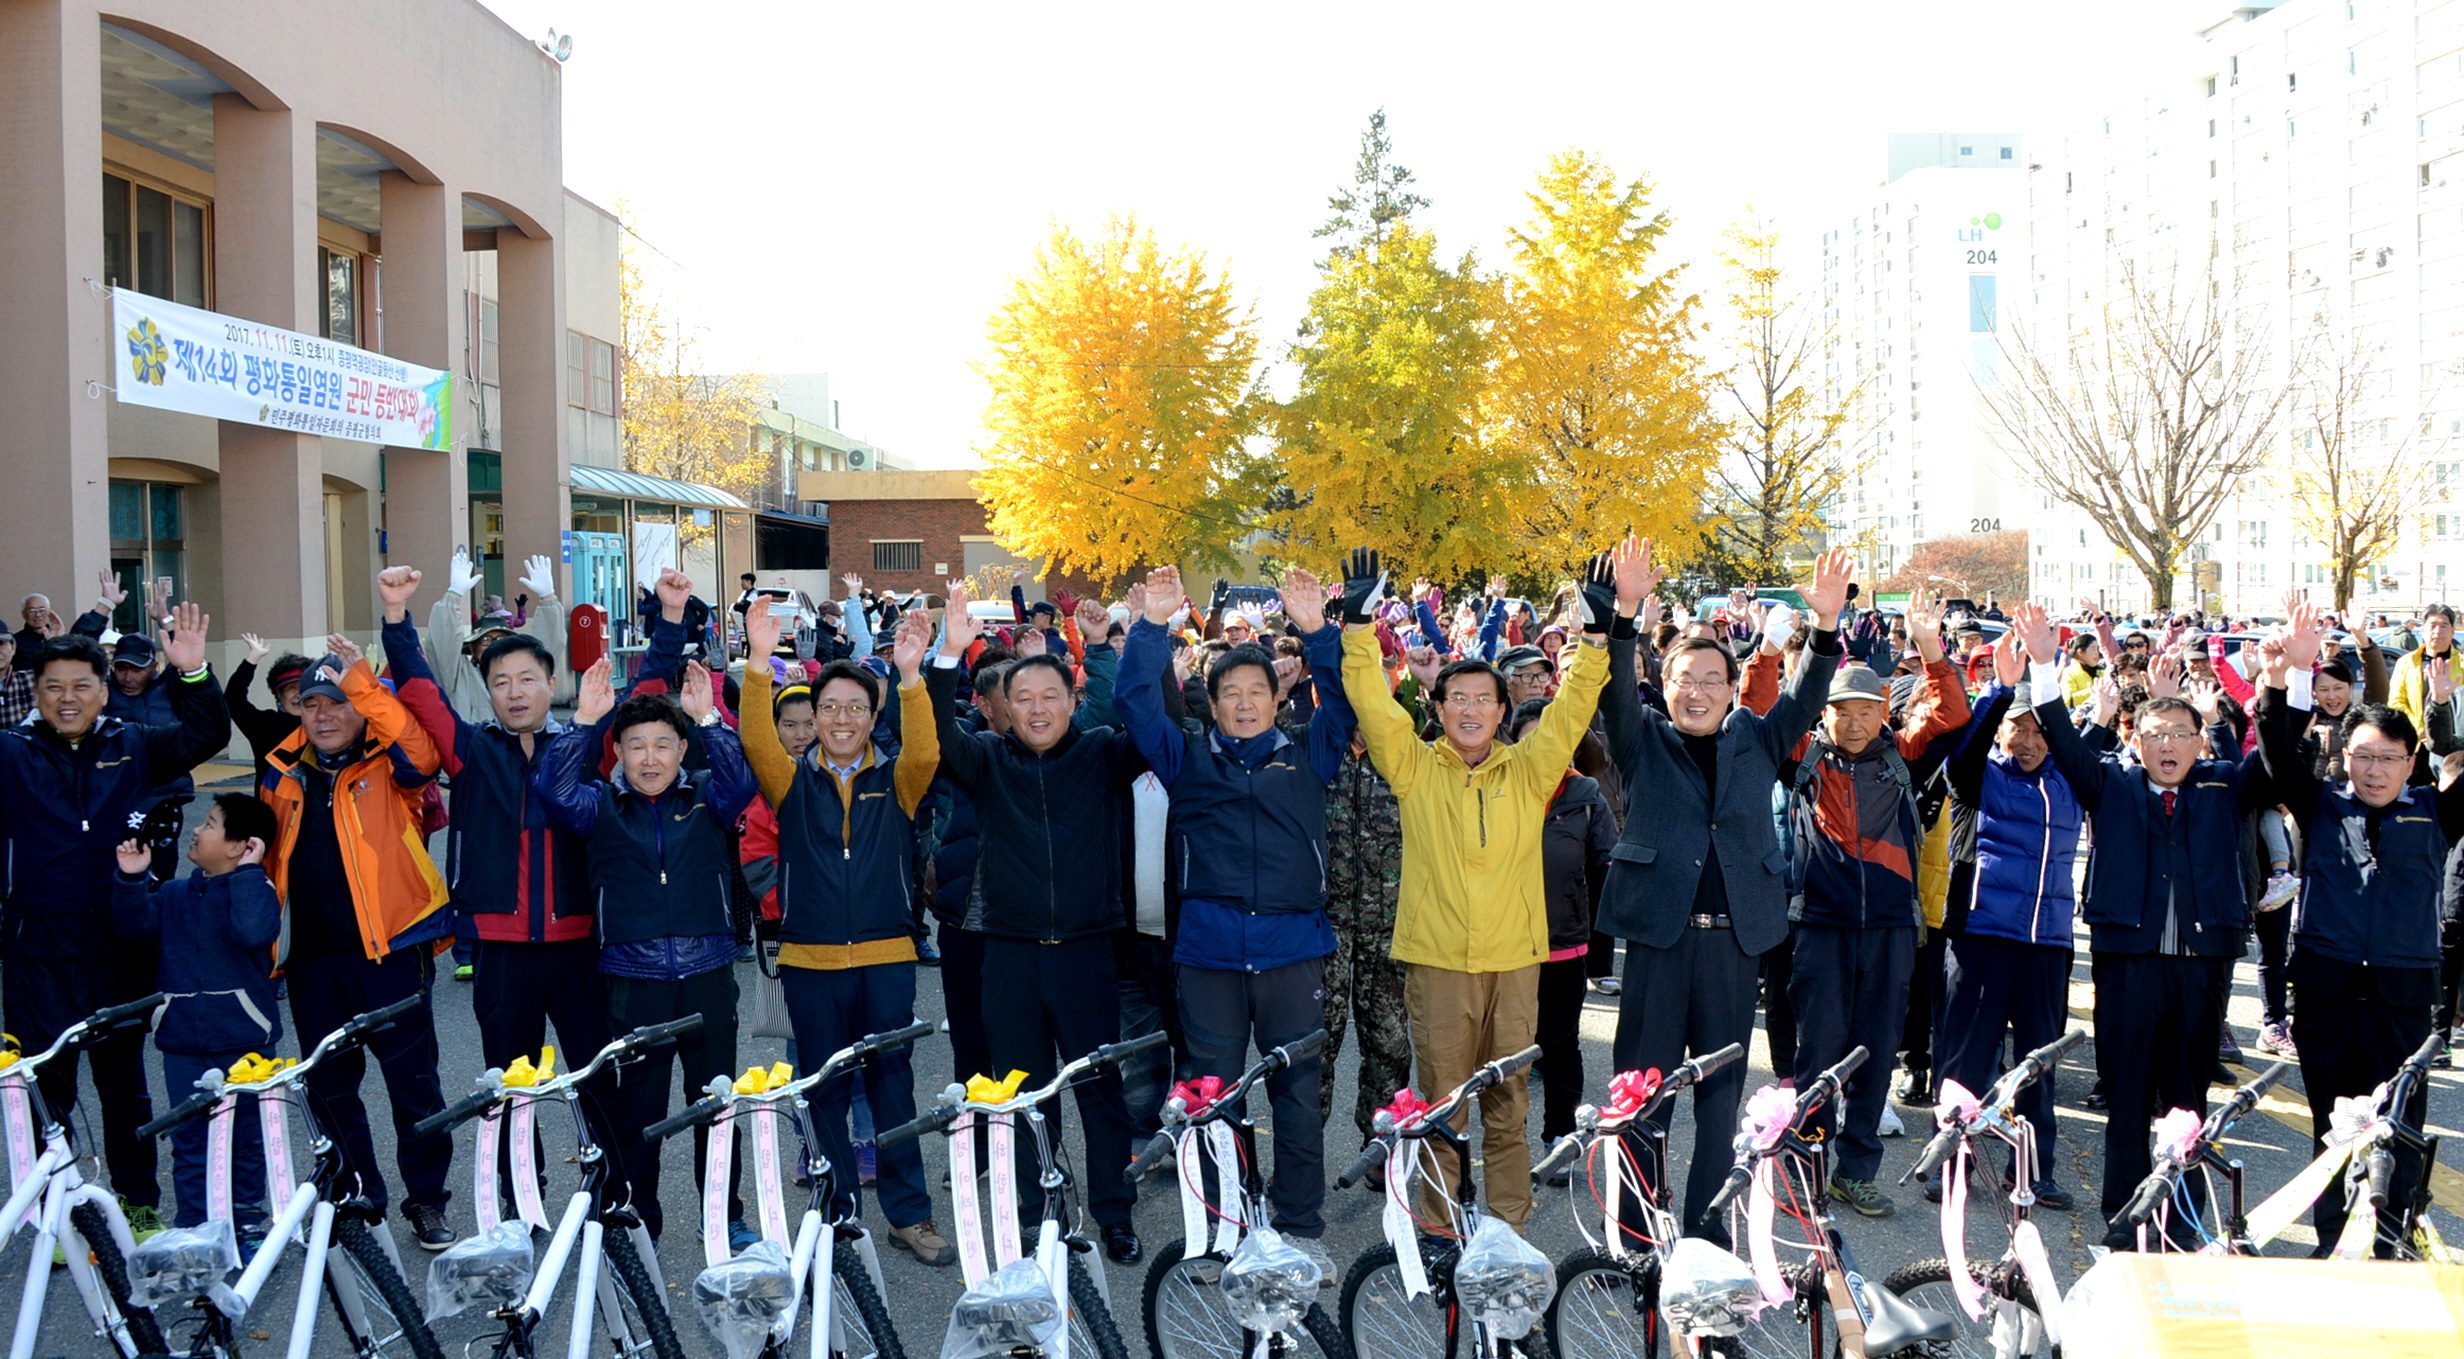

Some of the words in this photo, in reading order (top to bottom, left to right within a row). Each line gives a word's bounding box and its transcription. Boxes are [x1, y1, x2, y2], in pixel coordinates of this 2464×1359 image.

[1958, 228, 1983, 242] LH
[1966, 249, 1998, 265] 204
[173, 338, 238, 392] 제14회
[243, 353, 342, 412] 평화통일염원
[346, 376, 373, 416] 군민
[374, 383, 420, 424] 등반대회
[1970, 517, 2002, 533] 204
